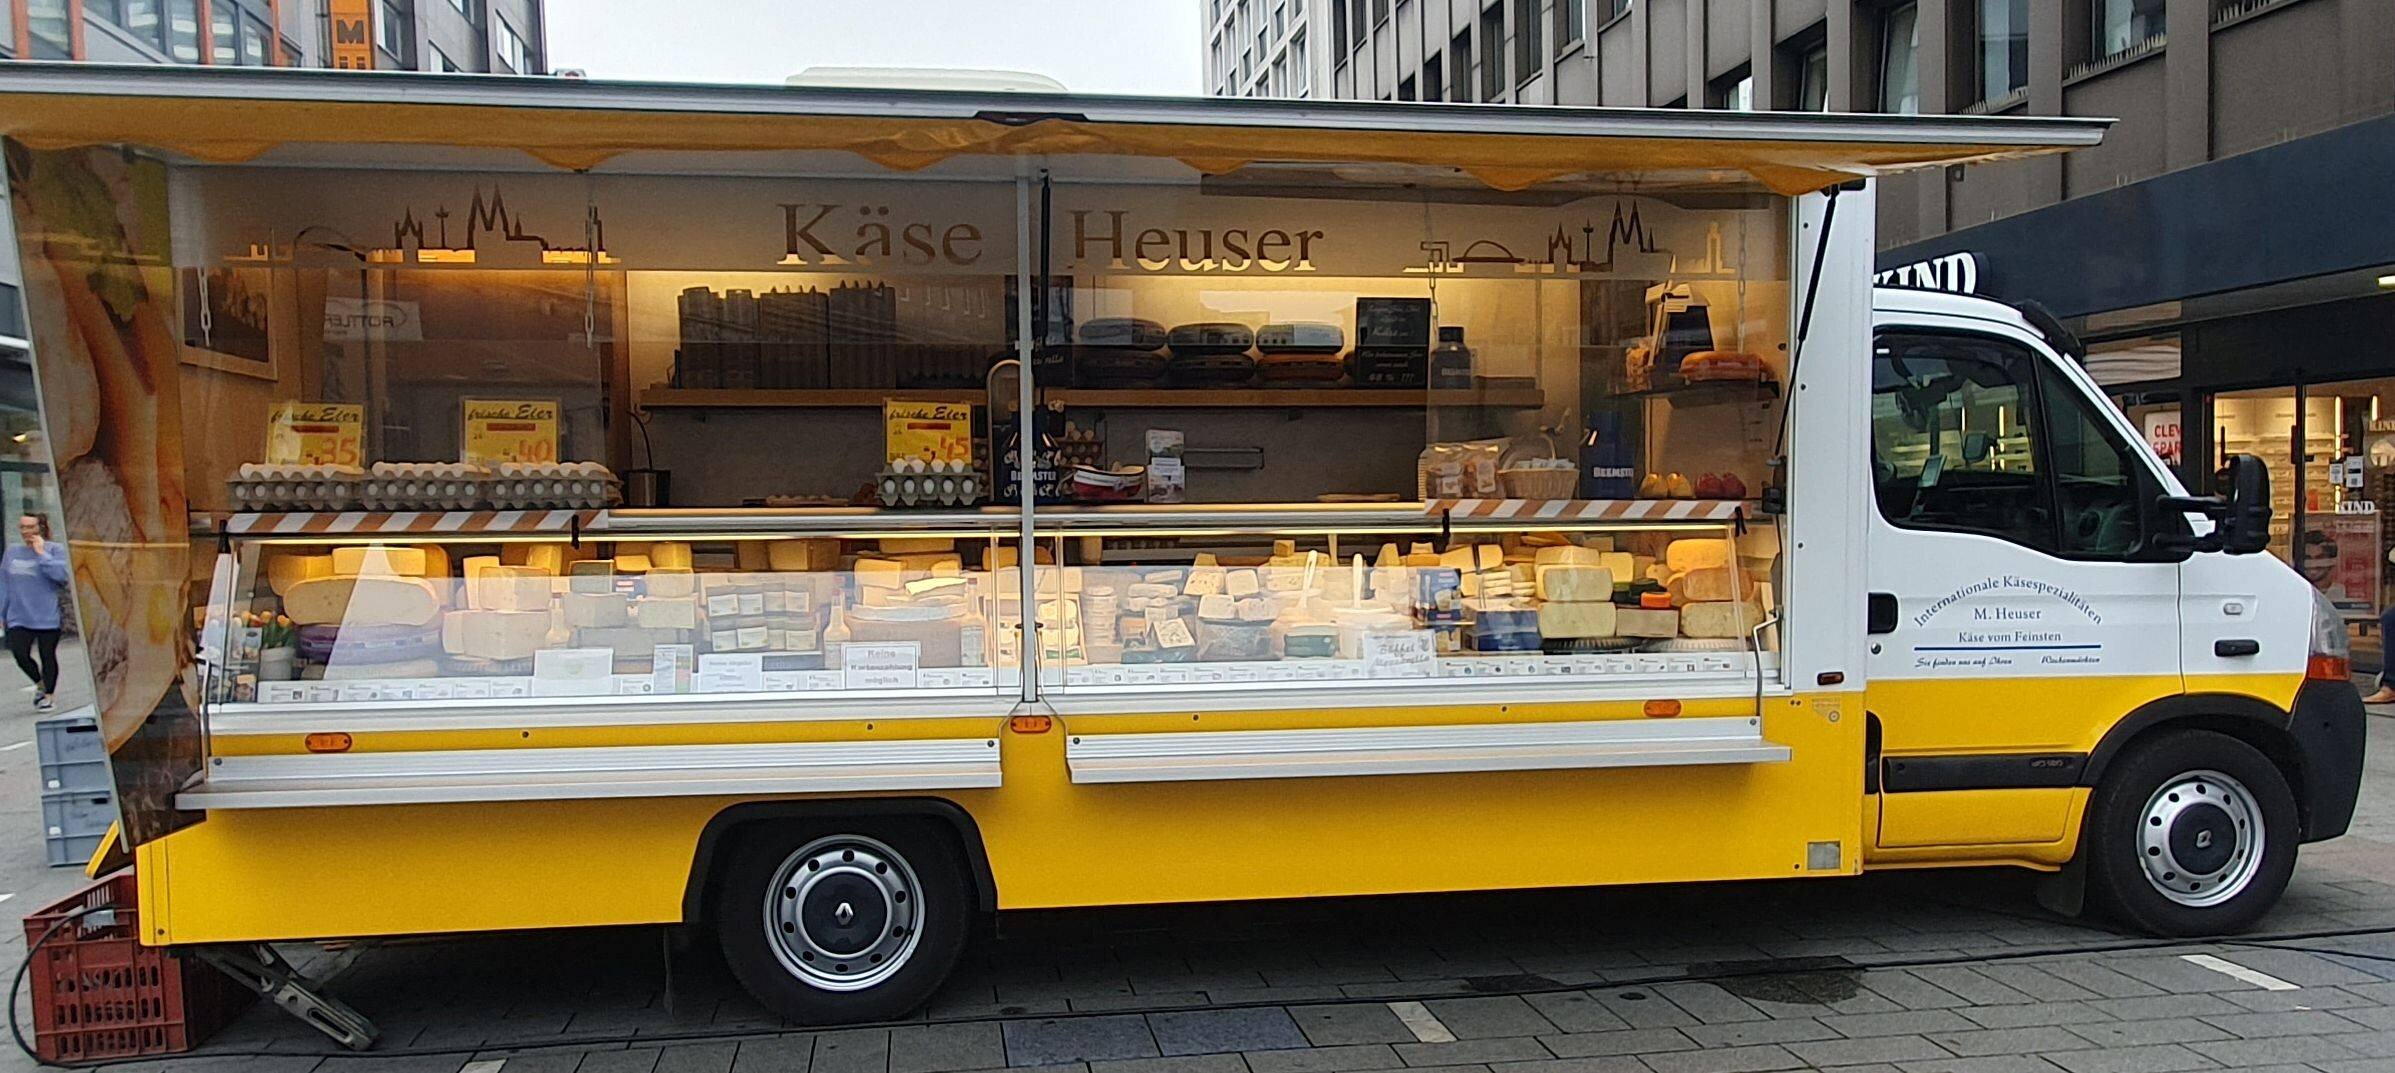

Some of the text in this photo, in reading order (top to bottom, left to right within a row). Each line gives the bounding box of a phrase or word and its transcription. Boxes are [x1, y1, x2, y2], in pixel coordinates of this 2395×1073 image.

[776, 203, 1324, 272] Käse Heuser
[317, 406, 360, 423] Eier
[467, 404, 553, 421] frische Eier
[889, 406, 968, 421] frische Eier
[2340, 500, 2376, 515] KIND
[1914, 575, 2102, 628] Internationale Käsespezialitäten
[1974, 607, 2042, 620] M. Heuser
[1959, 631, 2061, 643] Käse vom Feinsten
[867, 650, 896, 659] Keine
[850, 664, 913, 672] Kartenzahlung
[1915, 657, 1931, 668] Sie
[1932, 656, 1957, 669] finden
[1972, 657, 1986, 667] auf
